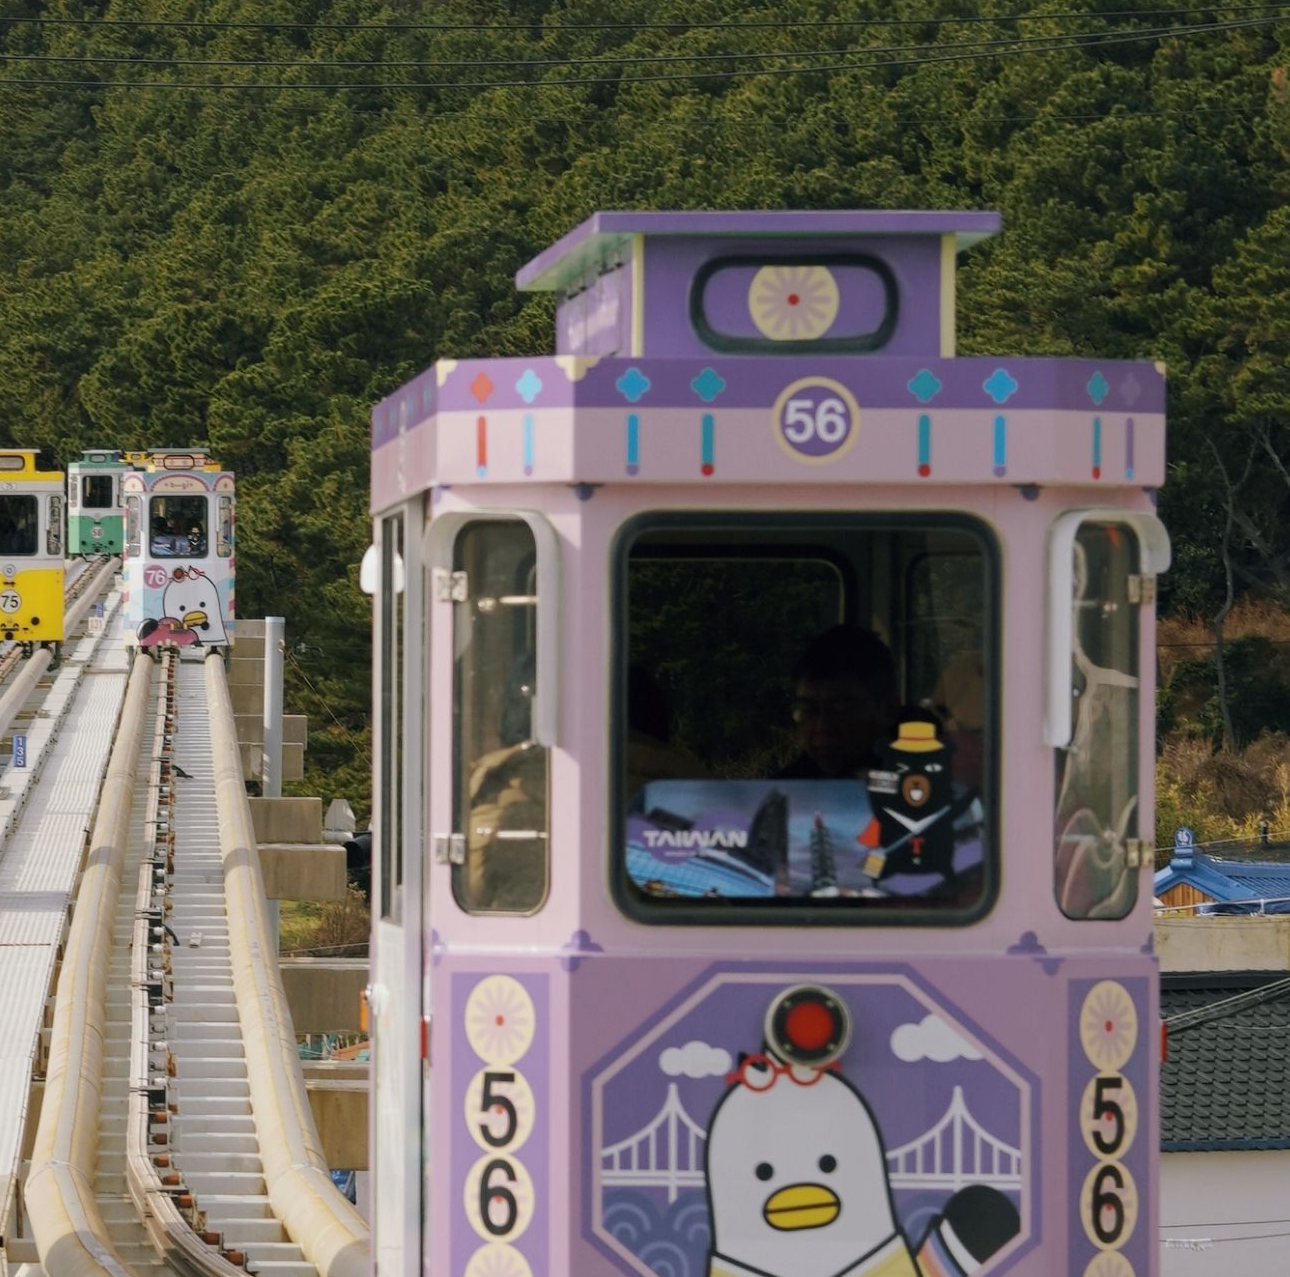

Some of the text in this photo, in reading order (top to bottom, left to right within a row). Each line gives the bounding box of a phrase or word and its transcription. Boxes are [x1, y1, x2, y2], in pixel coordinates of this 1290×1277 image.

[783, 400, 846, 443] 56
[145, 569, 166, 585] 76
[0, 595, 19, 609] 75
[16, 737, 24, 766] 135
[643, 829, 748, 848] TAIWAN
[478, 1072, 519, 1237] 56
[1091, 1077, 1125, 1244] 56
